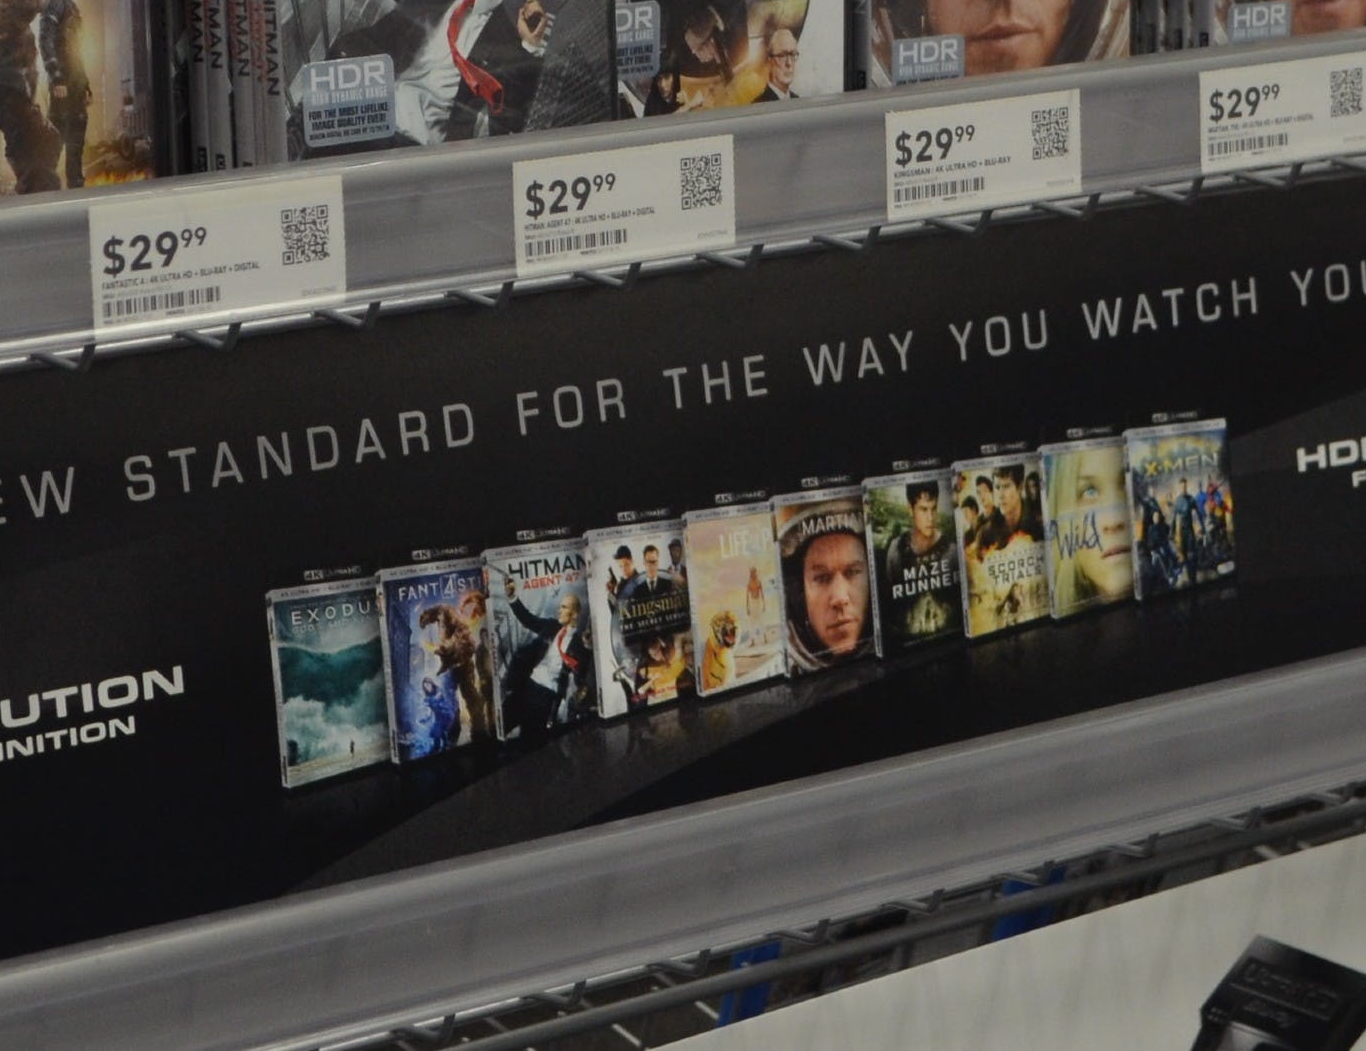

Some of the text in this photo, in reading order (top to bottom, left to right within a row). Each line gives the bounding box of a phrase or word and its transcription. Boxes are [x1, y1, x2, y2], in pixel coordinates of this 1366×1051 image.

[1233, 4, 1287, 28] HDR
[898, 38, 959, 65] HDR
[310, 60, 387, 92] HDR
[124, 402, 476, 505] STANDARD
[517, 376, 627, 438] FOR
[662, 354, 770, 412] THE
[801, 329, 915, 386] WAY
[947, 308, 1050, 364] YOU
[1082, 276, 1260, 341] WATCH
[1049, 510, 1104, 561] Wild
[902, 558, 952, 580] MAZE
[987, 555, 1045, 577] SCORCH
[522, 569, 580, 591] AGENT 47
[290, 600, 371, 627] EXODU
